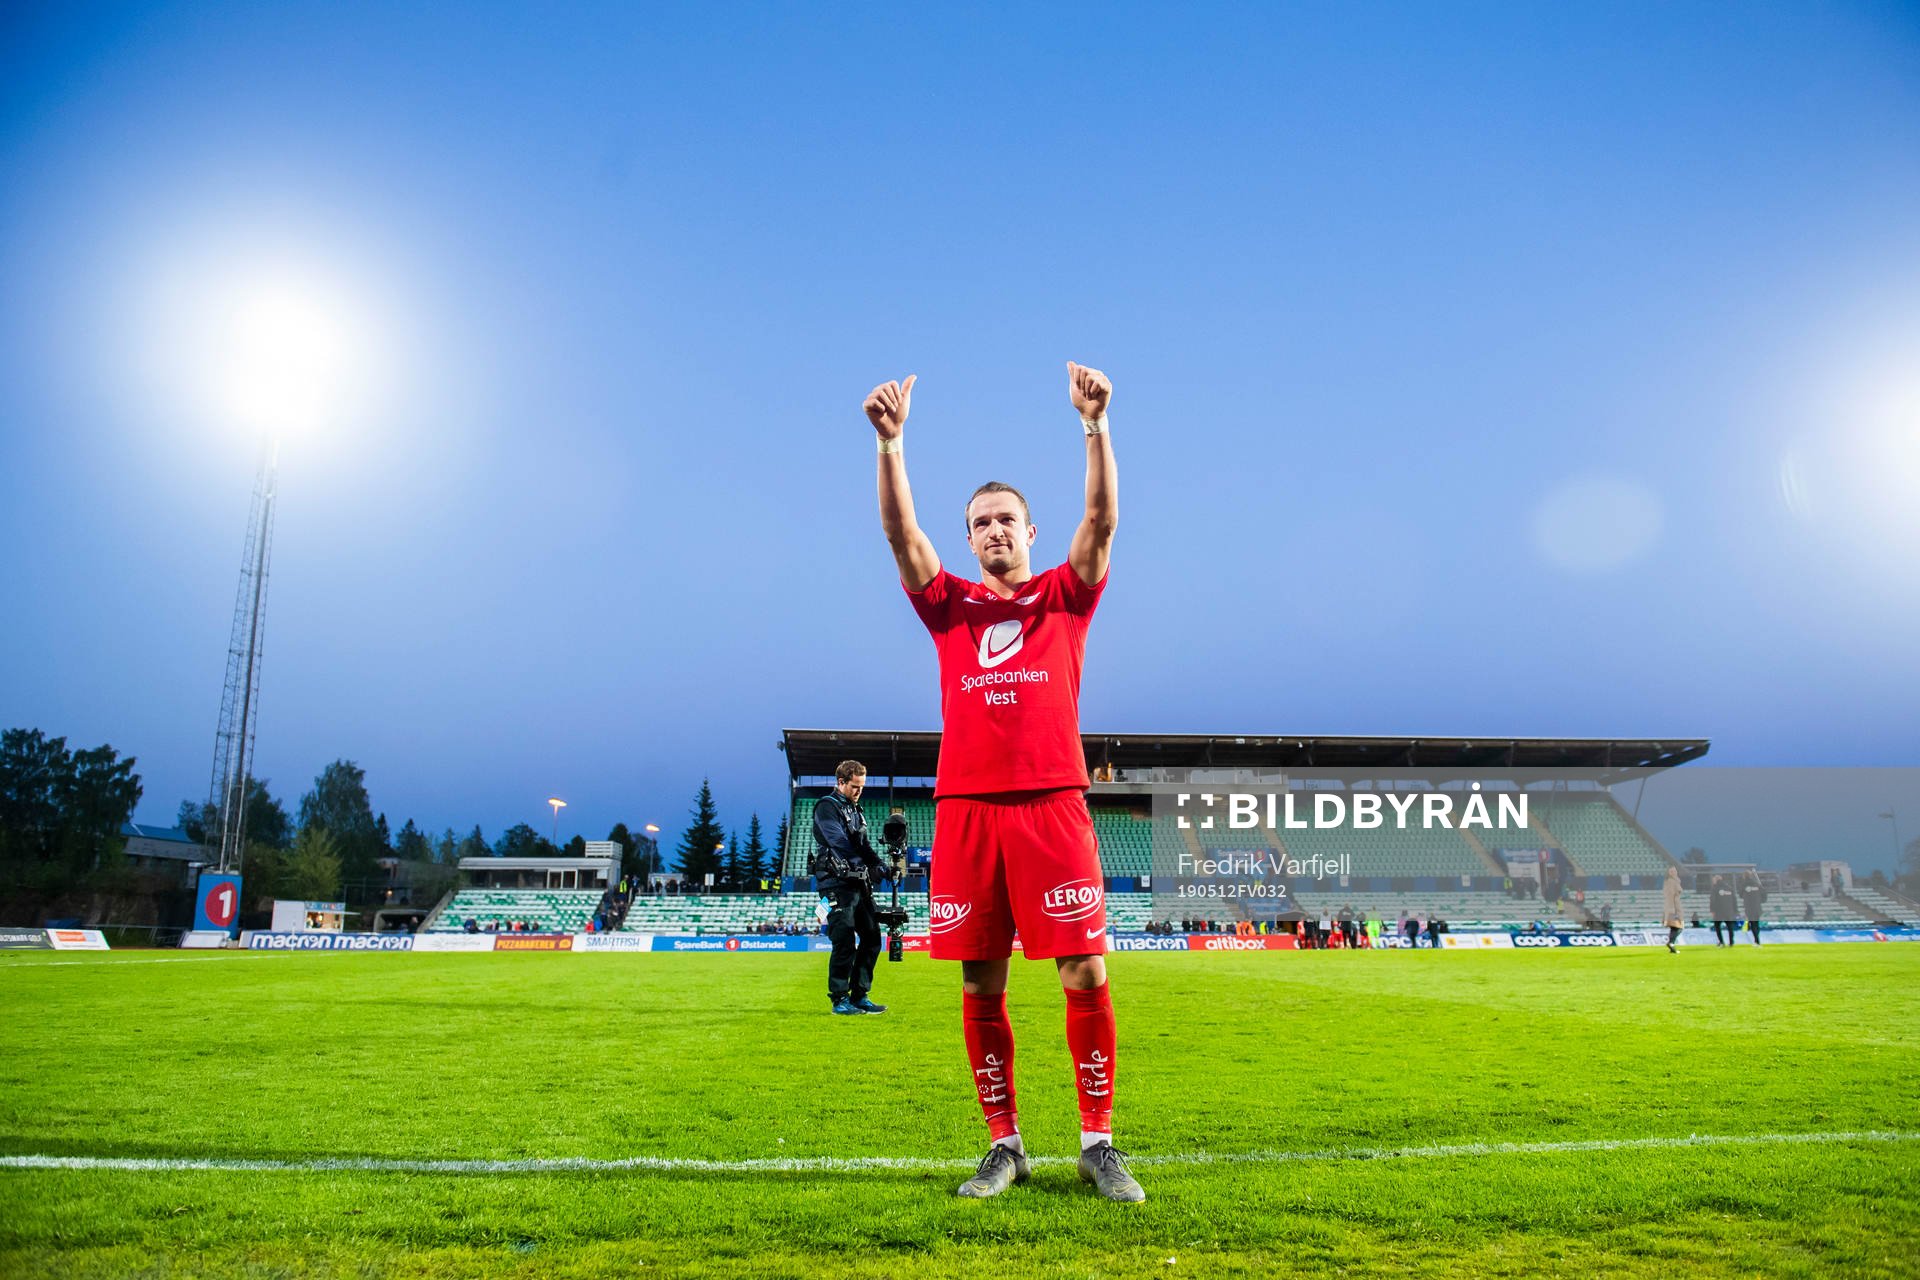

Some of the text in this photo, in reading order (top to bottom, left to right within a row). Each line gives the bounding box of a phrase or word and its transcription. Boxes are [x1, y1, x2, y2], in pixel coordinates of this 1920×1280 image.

[961, 668, 1048, 693] Sparebanken
[985, 690, 1018, 706] Vest
[218, 890, 233, 918] 1
[1044, 886, 1101, 908] LERØY
[252, 934, 412, 950] macron macron
[674, 940, 724, 950] SpareBank
[741, 940, 786, 949] Østlandet
[1115, 937, 1189, 950] macron
[1205, 937, 1267, 950] altibox
[1514, 935, 1561, 947] coop
[1568, 935, 1613, 947] coop
[976, 1053, 1007, 1104] tide
[1080, 1050, 1109, 1097] tide
